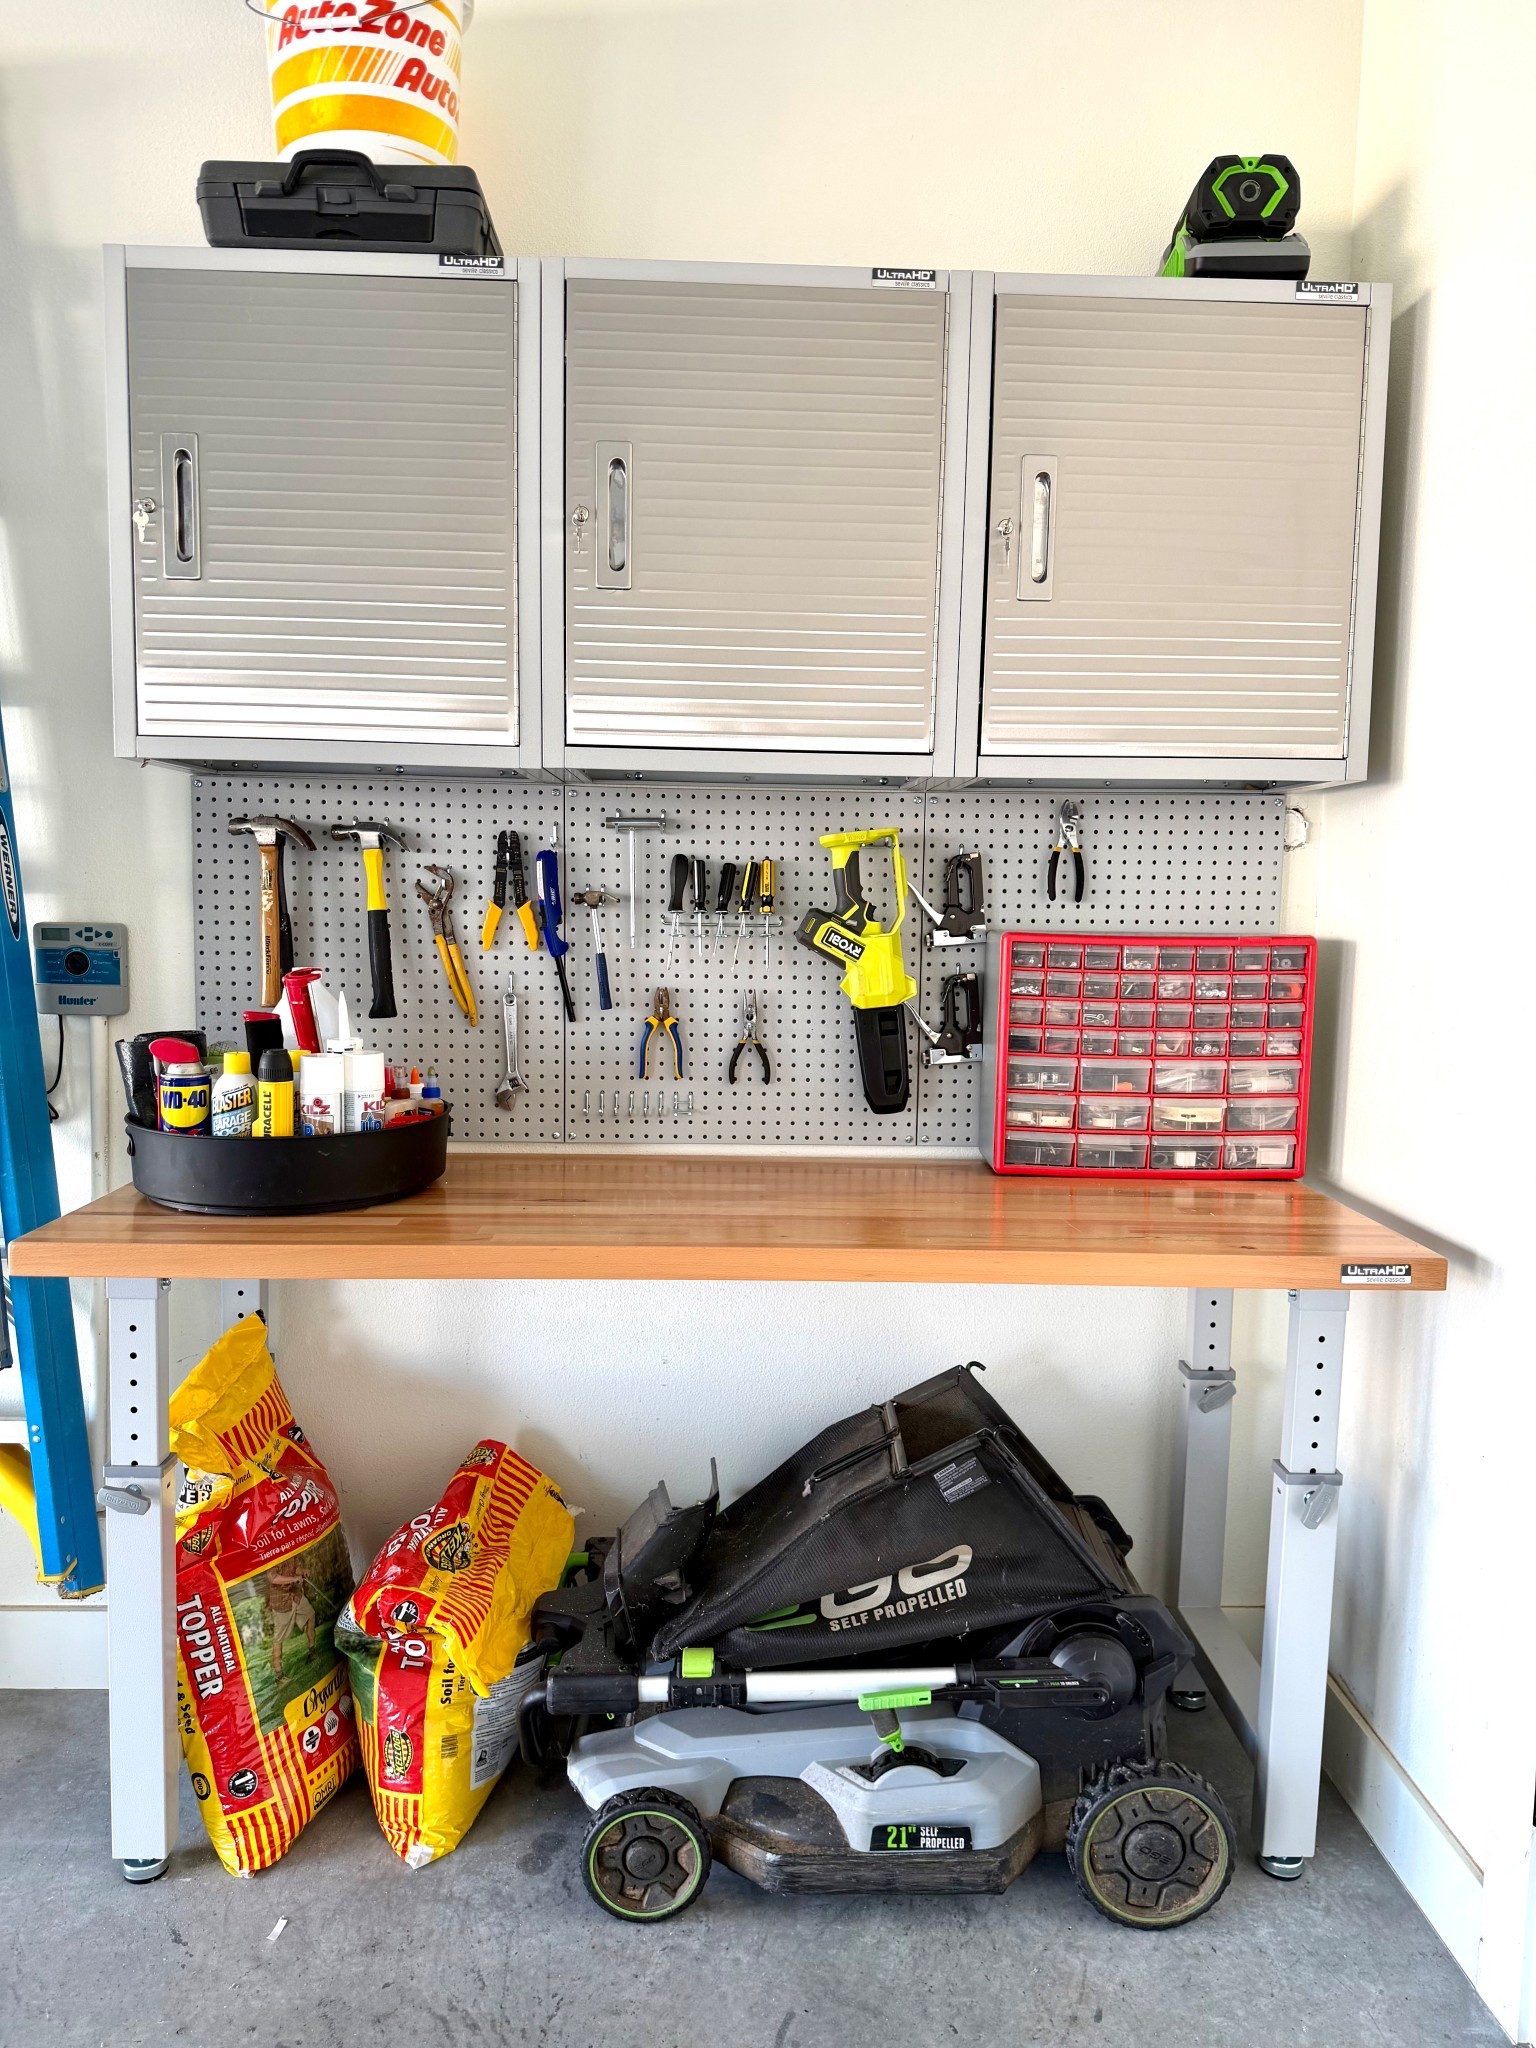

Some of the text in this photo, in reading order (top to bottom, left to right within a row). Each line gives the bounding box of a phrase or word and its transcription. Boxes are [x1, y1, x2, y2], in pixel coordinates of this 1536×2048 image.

[393, 57, 460, 124] Auto
[1, 834, 17, 914] WERNER
[828, 932, 862, 958] RYOBI
[58, 994, 97, 1006] Hunter
[162, 1089, 208, 1109] WD-40
[213, 1110, 251, 1132] GARAGE
[250, 1534, 271, 1552] Soil
[270, 1529, 287, 1542] for
[259, 1547, 280, 1561] Tierra
[280, 1540, 296, 1553] para
[830, 1578, 968, 1632] SELF PROPELLED
[176, 1593, 224, 1700] TOPPER
[210, 1605, 237, 1674] ALL NATURAL
[440, 1679, 454, 1705] Soil
[181, 1703, 196, 1735] Seed
[392, 1731, 405, 1774] KELLOGG
[315, 1777, 336, 1804] OMRI
[887, 1826, 939, 1849] 21" SELF
[920, 1837, 965, 1849] PROPELLED
